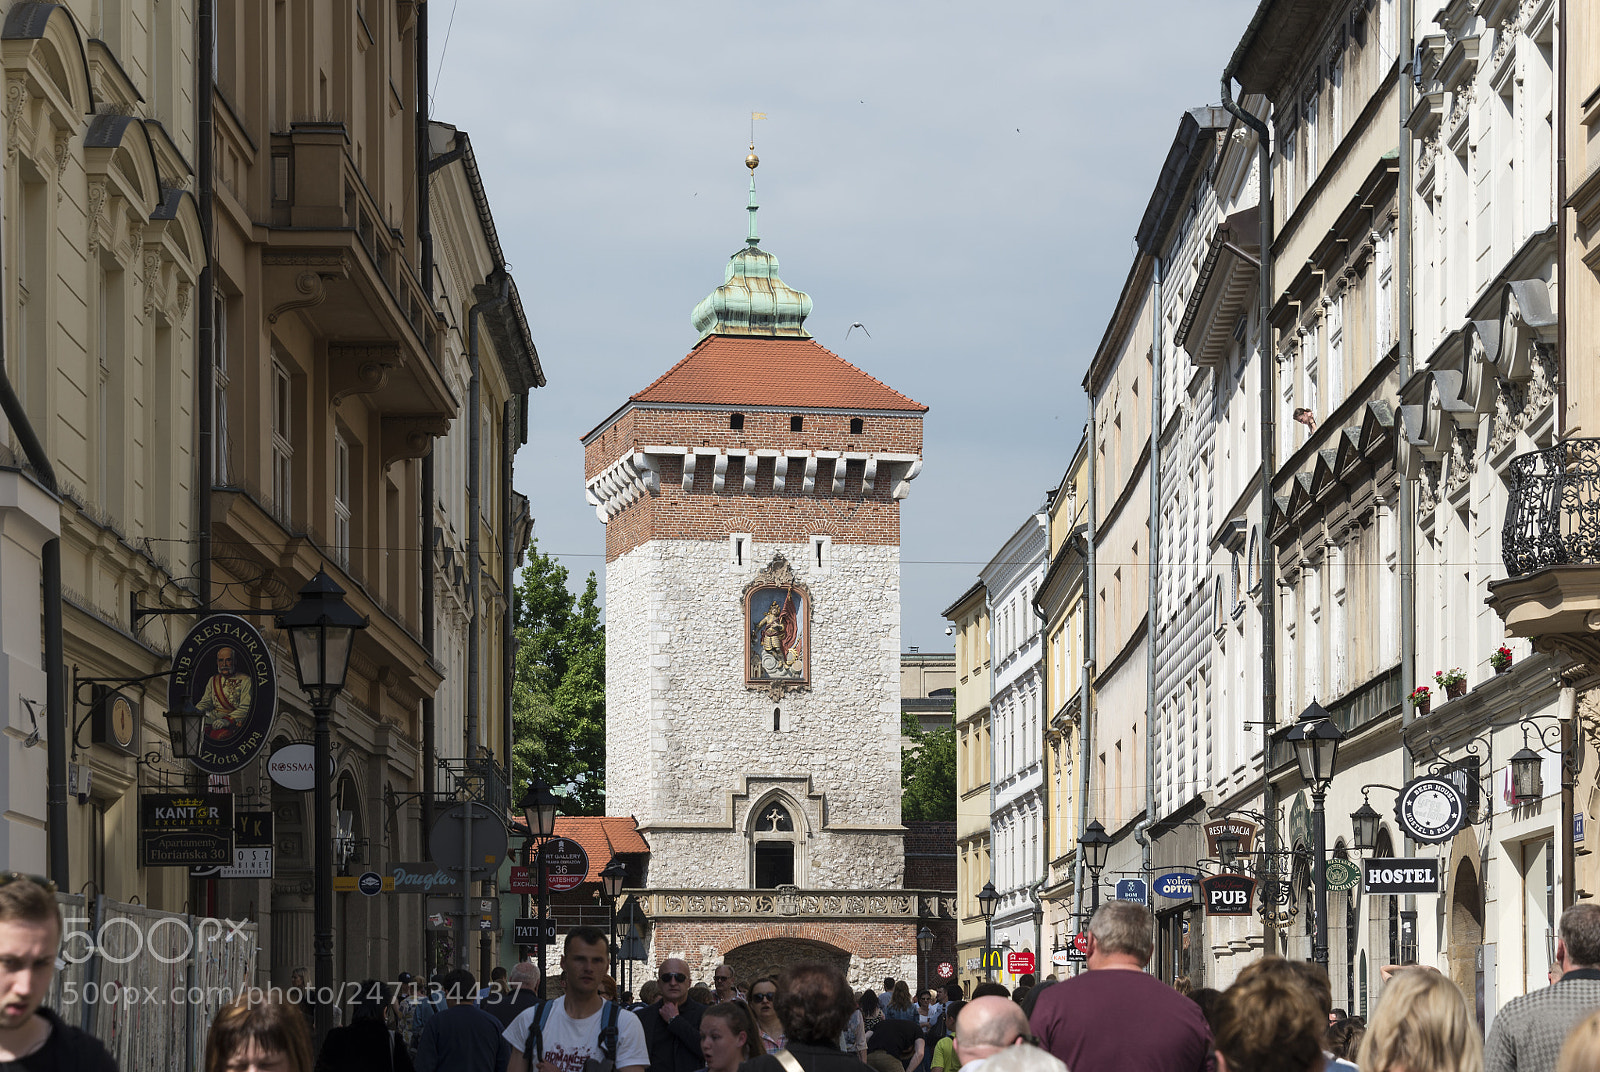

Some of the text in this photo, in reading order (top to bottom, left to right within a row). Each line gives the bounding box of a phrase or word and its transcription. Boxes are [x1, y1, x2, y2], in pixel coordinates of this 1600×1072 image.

[175, 623, 269, 687] PUB RESTAURACJA
[201, 730, 264, 766] Złotą Pipą
[271, 763, 314, 772] ROSSMA
[1413, 784, 1456, 803] BEER HOUSE
[155, 806, 219, 819] KANTOR
[1406, 813, 1427, 834] HOSTEL
[1437, 823, 1450, 834] PUB
[159, 839, 217, 849] Apartamenty
[151, 849, 226, 860] Floriańska 30
[555, 865, 568, 874] 36
[1368, 868, 1435, 884] HOSTEL
[1210, 890, 1247, 905] PUB
[515, 926, 556, 937] TATTO
